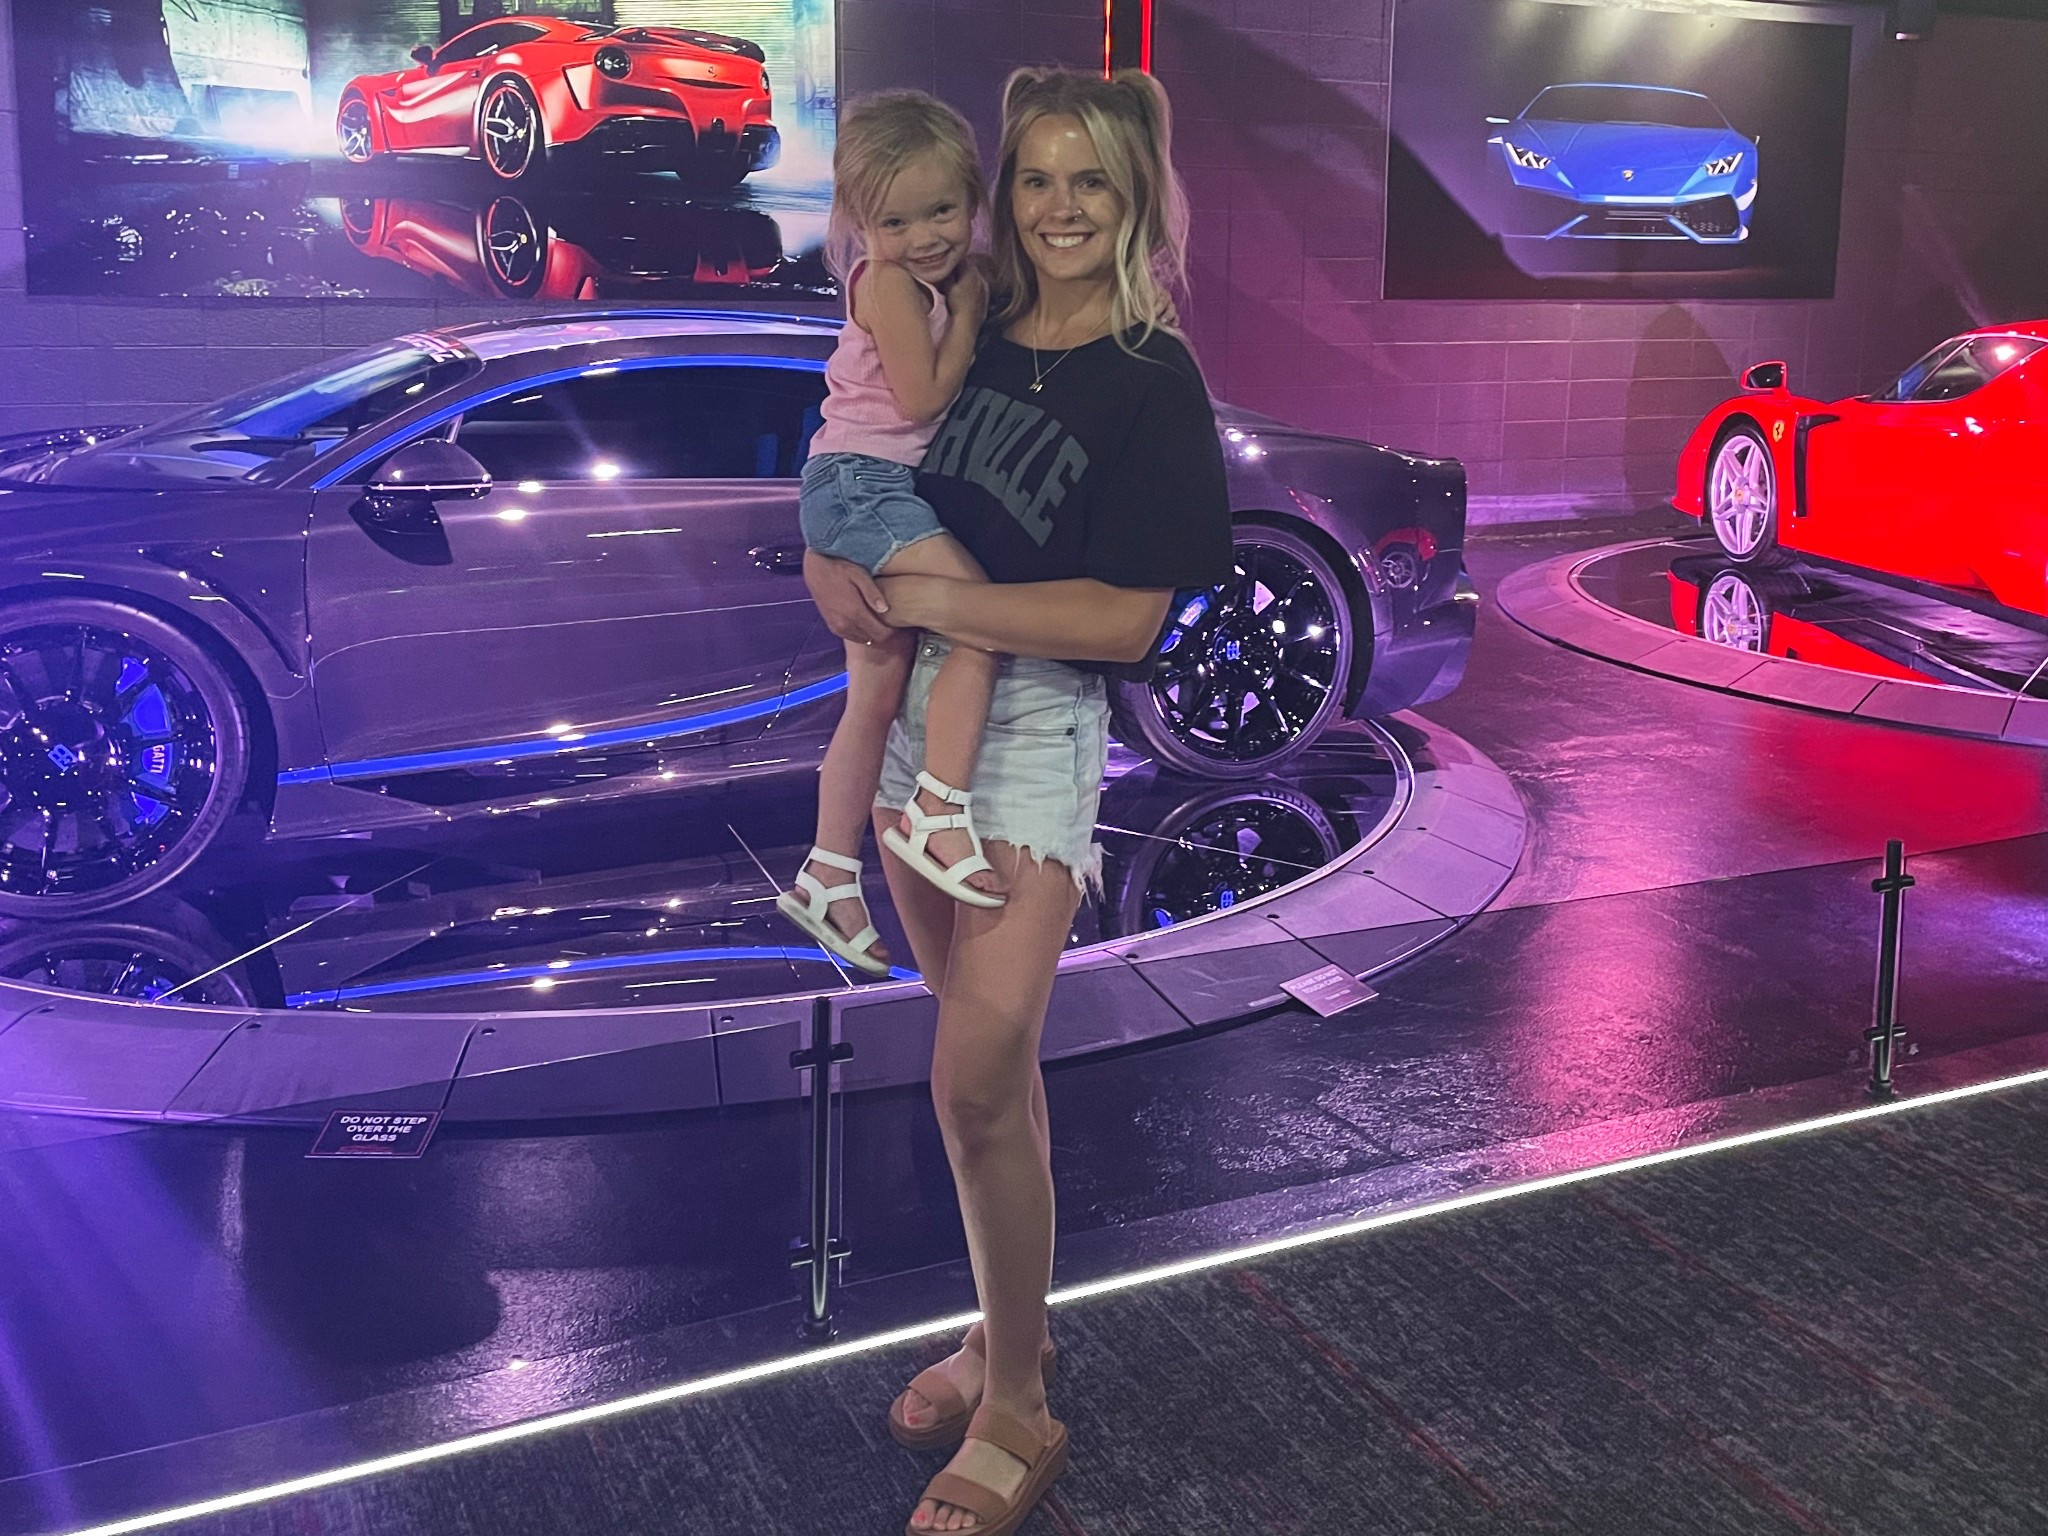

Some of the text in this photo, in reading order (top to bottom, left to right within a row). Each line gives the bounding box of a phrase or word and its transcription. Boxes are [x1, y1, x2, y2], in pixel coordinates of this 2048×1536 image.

[151, 743, 165, 774] GATTI
[340, 1116, 428, 1125] DO NOT STEP
[346, 1125, 413, 1134] OVER THE
[352, 1133, 397, 1142] GLASS
